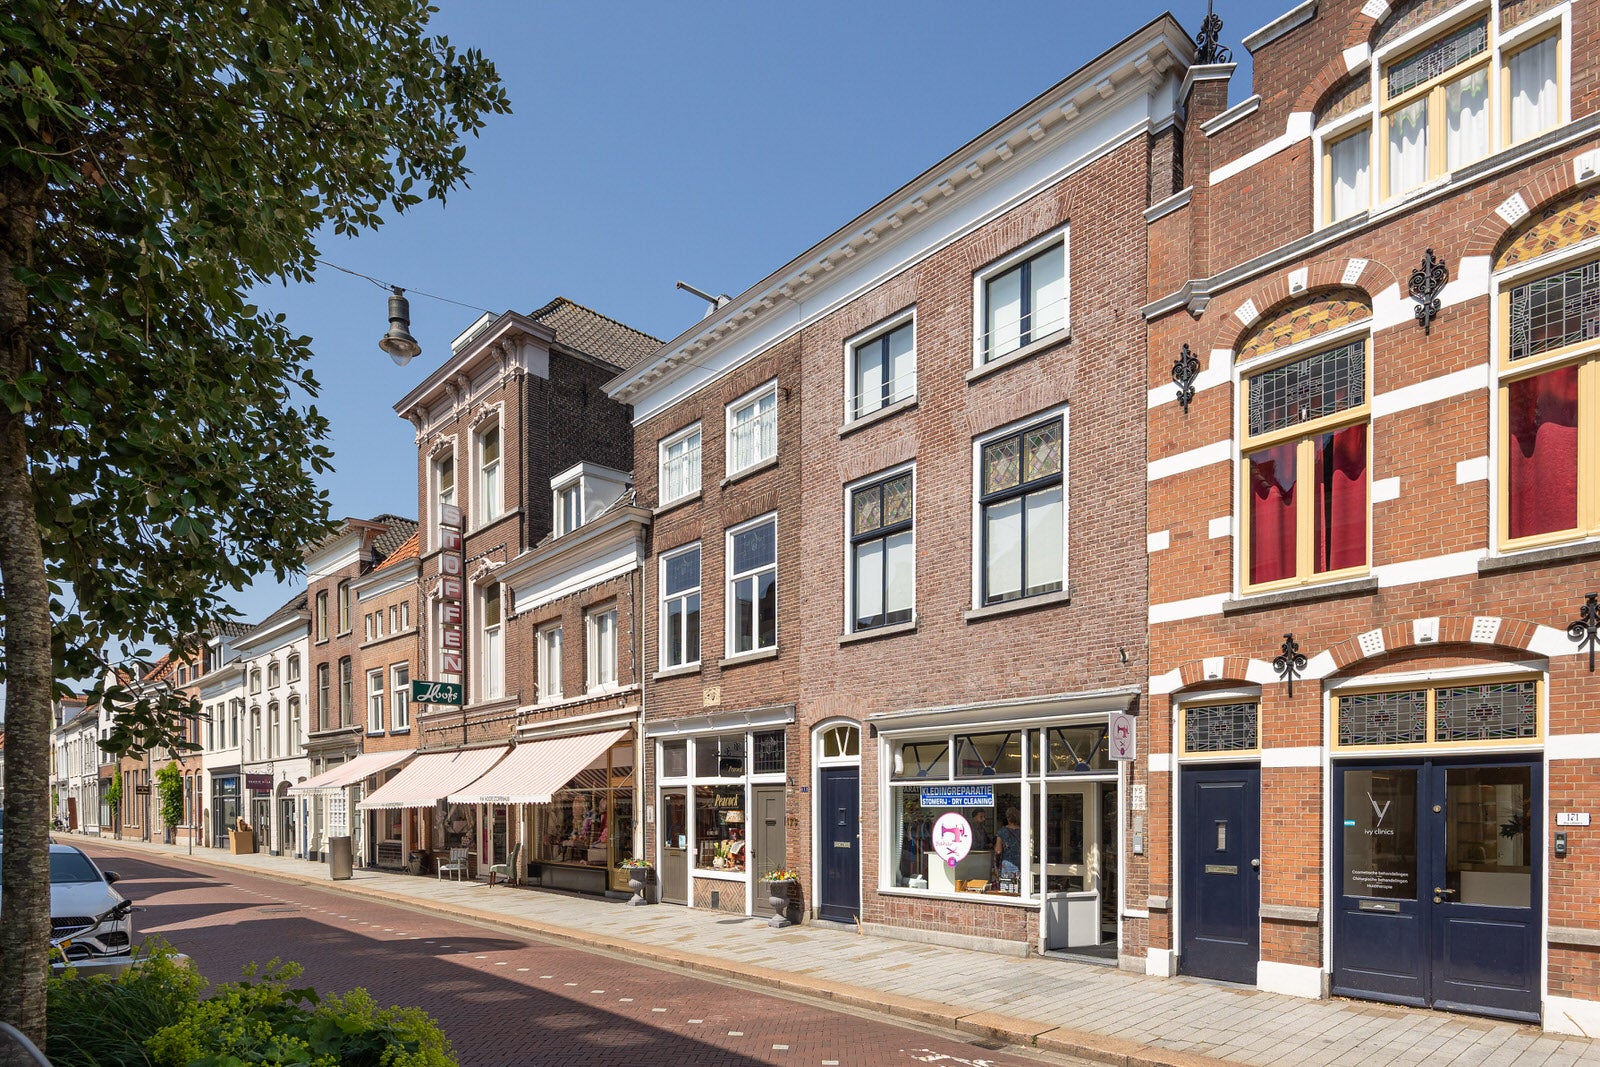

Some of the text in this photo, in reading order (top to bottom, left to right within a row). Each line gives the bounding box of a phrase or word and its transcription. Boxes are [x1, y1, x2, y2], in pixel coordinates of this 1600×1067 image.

[443, 506, 462, 672] STOFFEN
[922, 786, 992, 795] KLEDINGREPARATIE
[714, 794, 738, 807] Peacock
[952, 797, 963, 805] DRY
[963, 797, 993, 805] CLEANING
[1364, 828, 1374, 836] ivy
